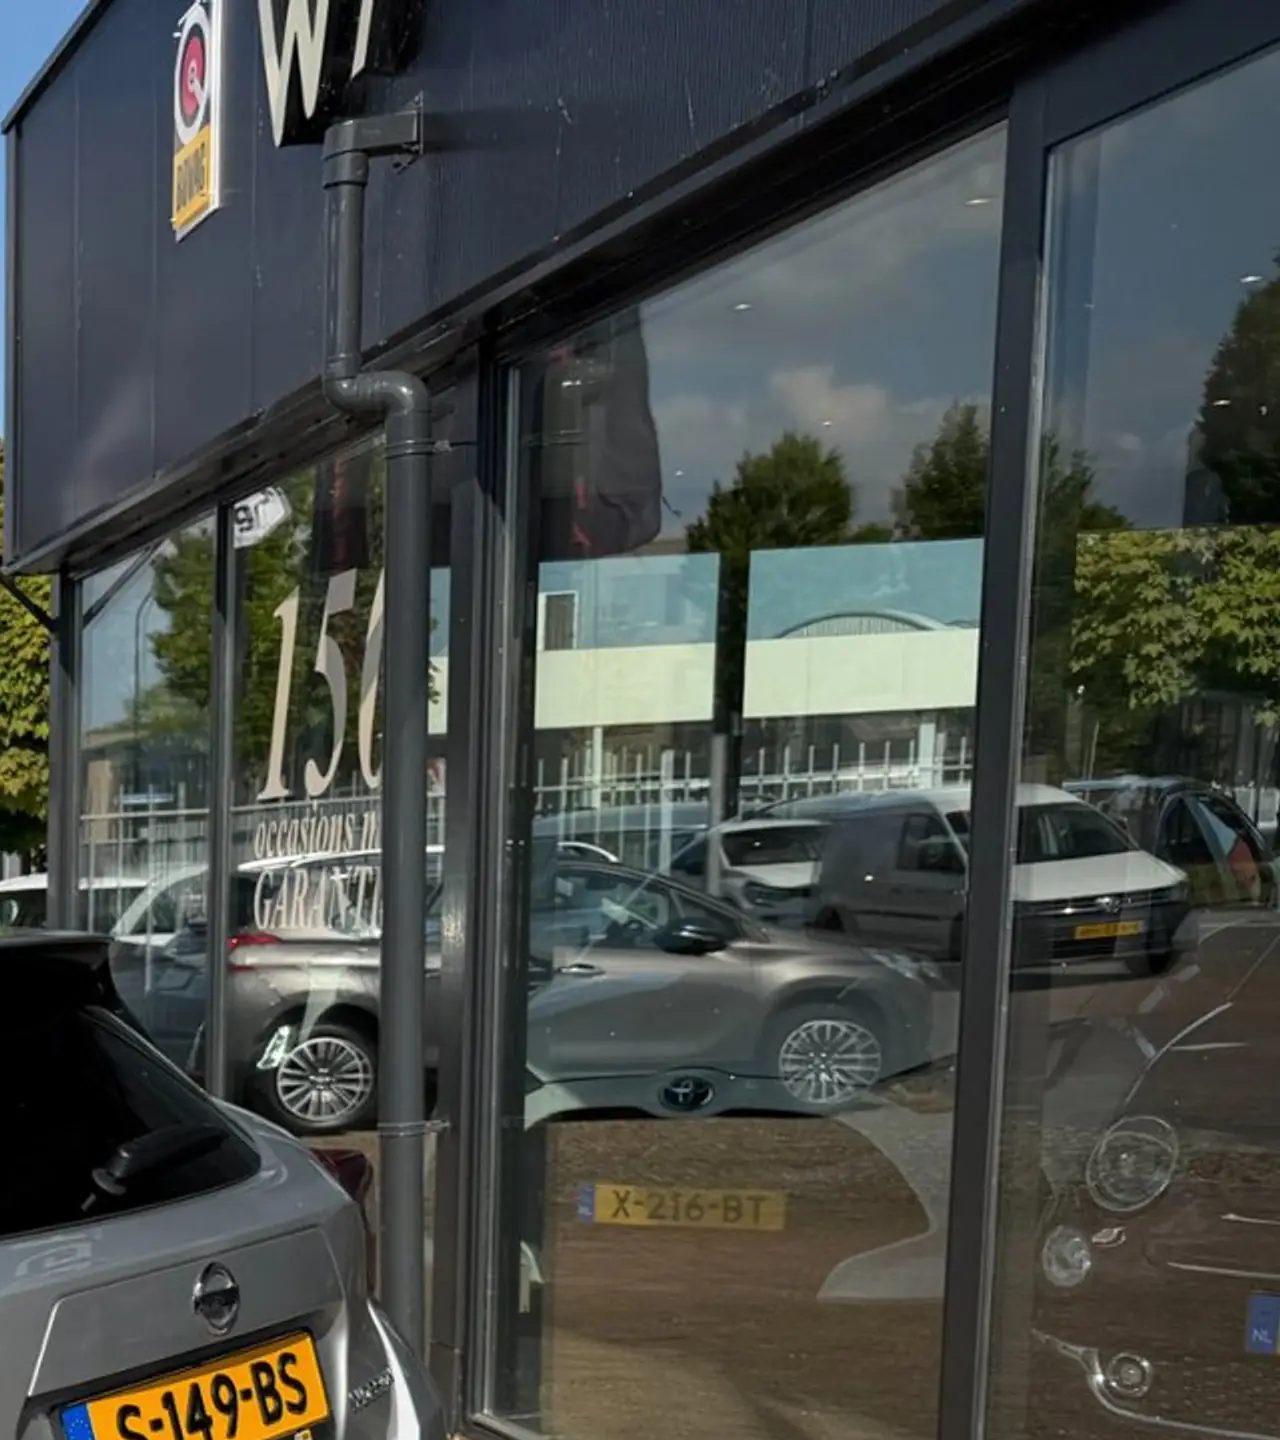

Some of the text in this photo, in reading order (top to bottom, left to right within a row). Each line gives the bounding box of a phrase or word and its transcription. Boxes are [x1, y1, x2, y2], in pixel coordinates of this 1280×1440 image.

[253, 806, 355, 860] occasions
[253, 865, 383, 931] GARANTI
[611, 1188, 769, 1225] X-216-BT
